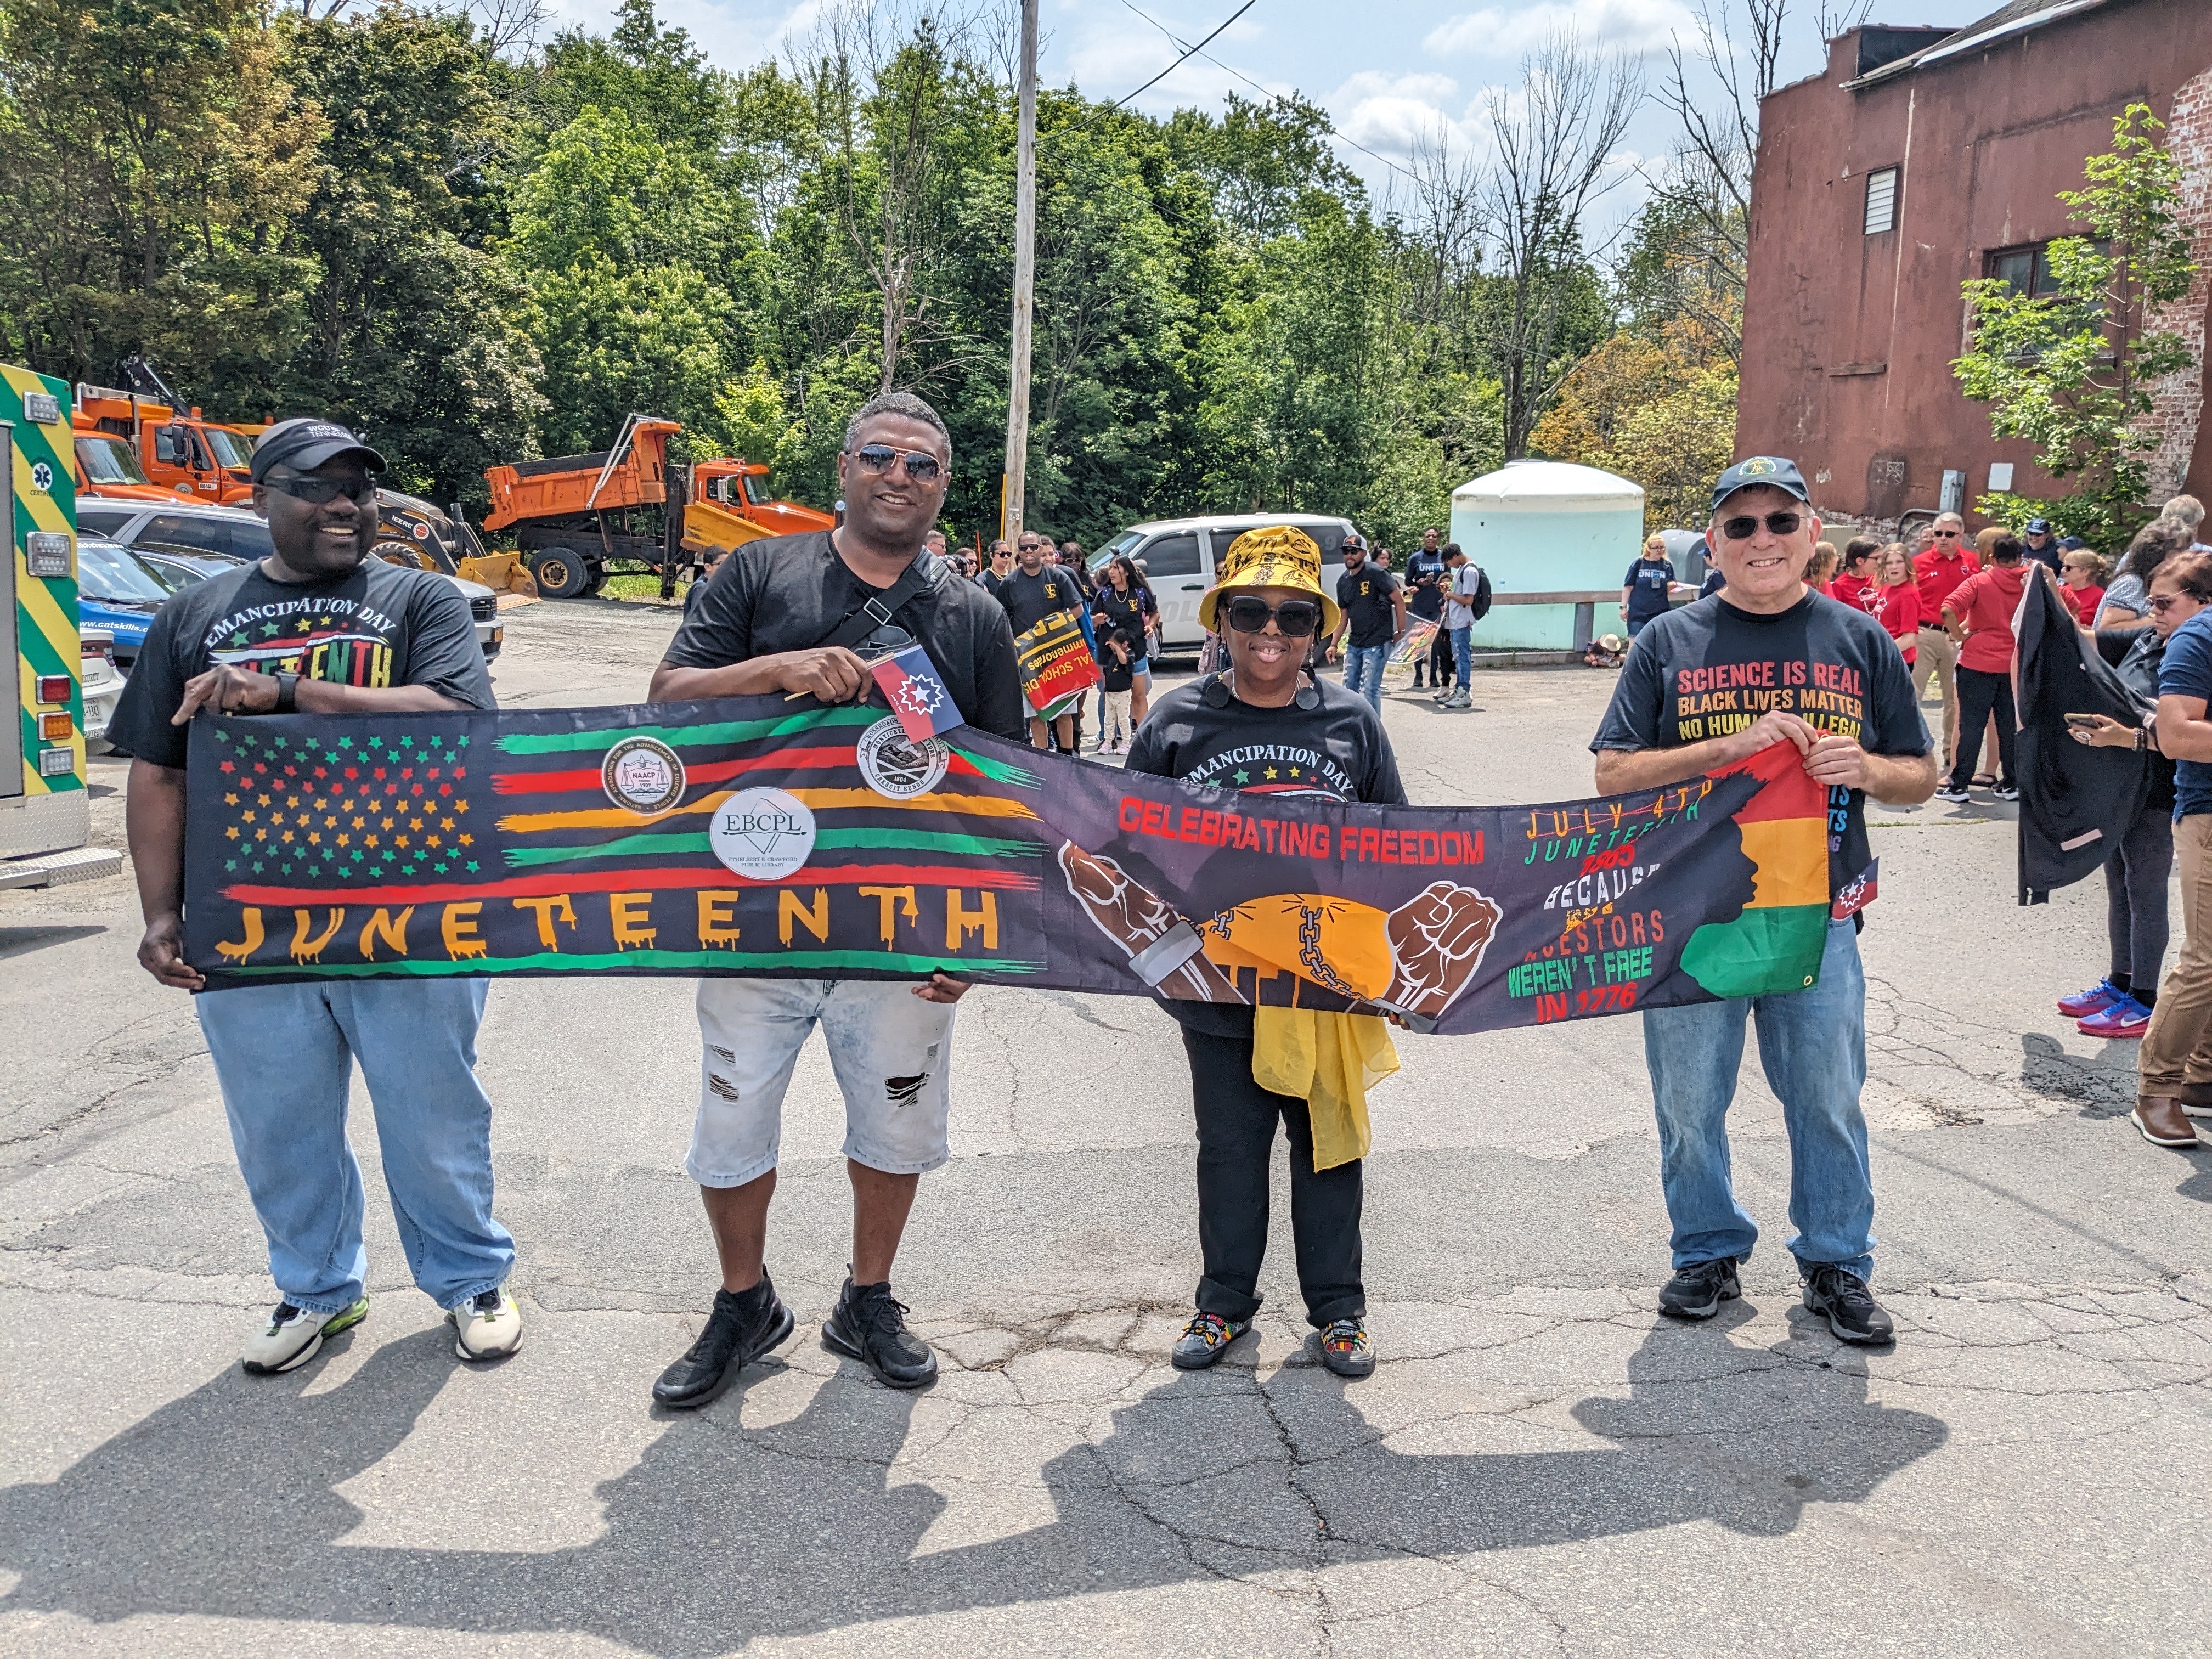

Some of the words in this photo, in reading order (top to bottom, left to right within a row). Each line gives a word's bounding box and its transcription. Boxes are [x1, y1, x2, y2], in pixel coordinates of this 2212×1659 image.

[204, 597, 360, 648] EMANCIPATION
[356, 606, 397, 634] DAY
[1678, 661, 1775, 694] SCIENCE
[1783, 661, 1807, 686] IS
[1814, 662, 1863, 696] REAL
[1678, 690, 1738, 717] BLACK
[1743, 689, 1794, 710] LIVES
[1800, 689, 1863, 720] MATTER
[864, 718, 898, 742] CROSSROADS
[873, 728, 906, 749] MONTICELL
[926, 742, 936, 758] YORK
[1678, 718, 1702, 741] NO
[1707, 712, 1757, 736] HUM
[614, 749, 623, 760] FOR
[623, 743, 634, 751] THE
[637, 742, 674, 763] ADVANCEMENT
[672, 763, 679, 771] OF
[874, 773, 901, 792] CRESCIT
[903, 779, 925, 792] EUNDO
[1321, 759, 1355, 794] DAY
[725, 814, 802, 831] EBCPL
[1118, 796, 1330, 860] CELEBRATING
[1340, 826, 1485, 866] FREEDOM
[1526, 803, 1622, 839] JULY
[215, 884, 1000, 967] JUNETEENTH
[1602, 946, 1653, 985] FREE
[1536, 991, 1567, 1023] IN
[1577, 981, 1638, 1013] 1776
